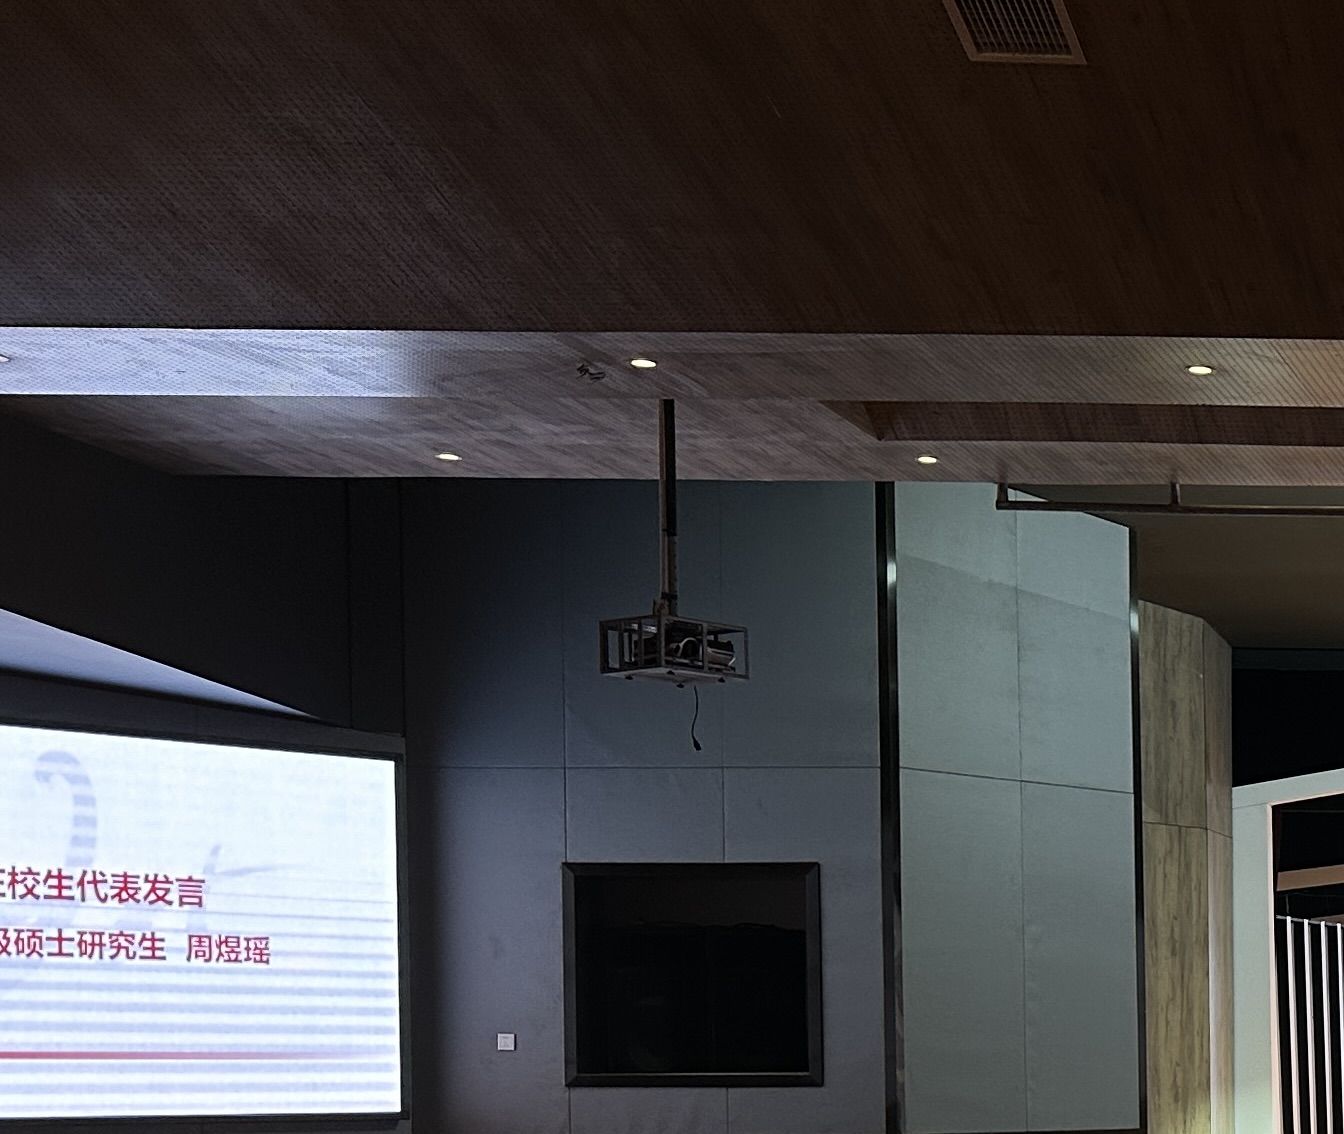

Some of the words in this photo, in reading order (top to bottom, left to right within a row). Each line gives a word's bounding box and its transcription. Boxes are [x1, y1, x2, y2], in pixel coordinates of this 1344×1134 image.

[0, 866, 206, 908] 校生代表发言
[186, 934, 271, 965] 周煜瑶
